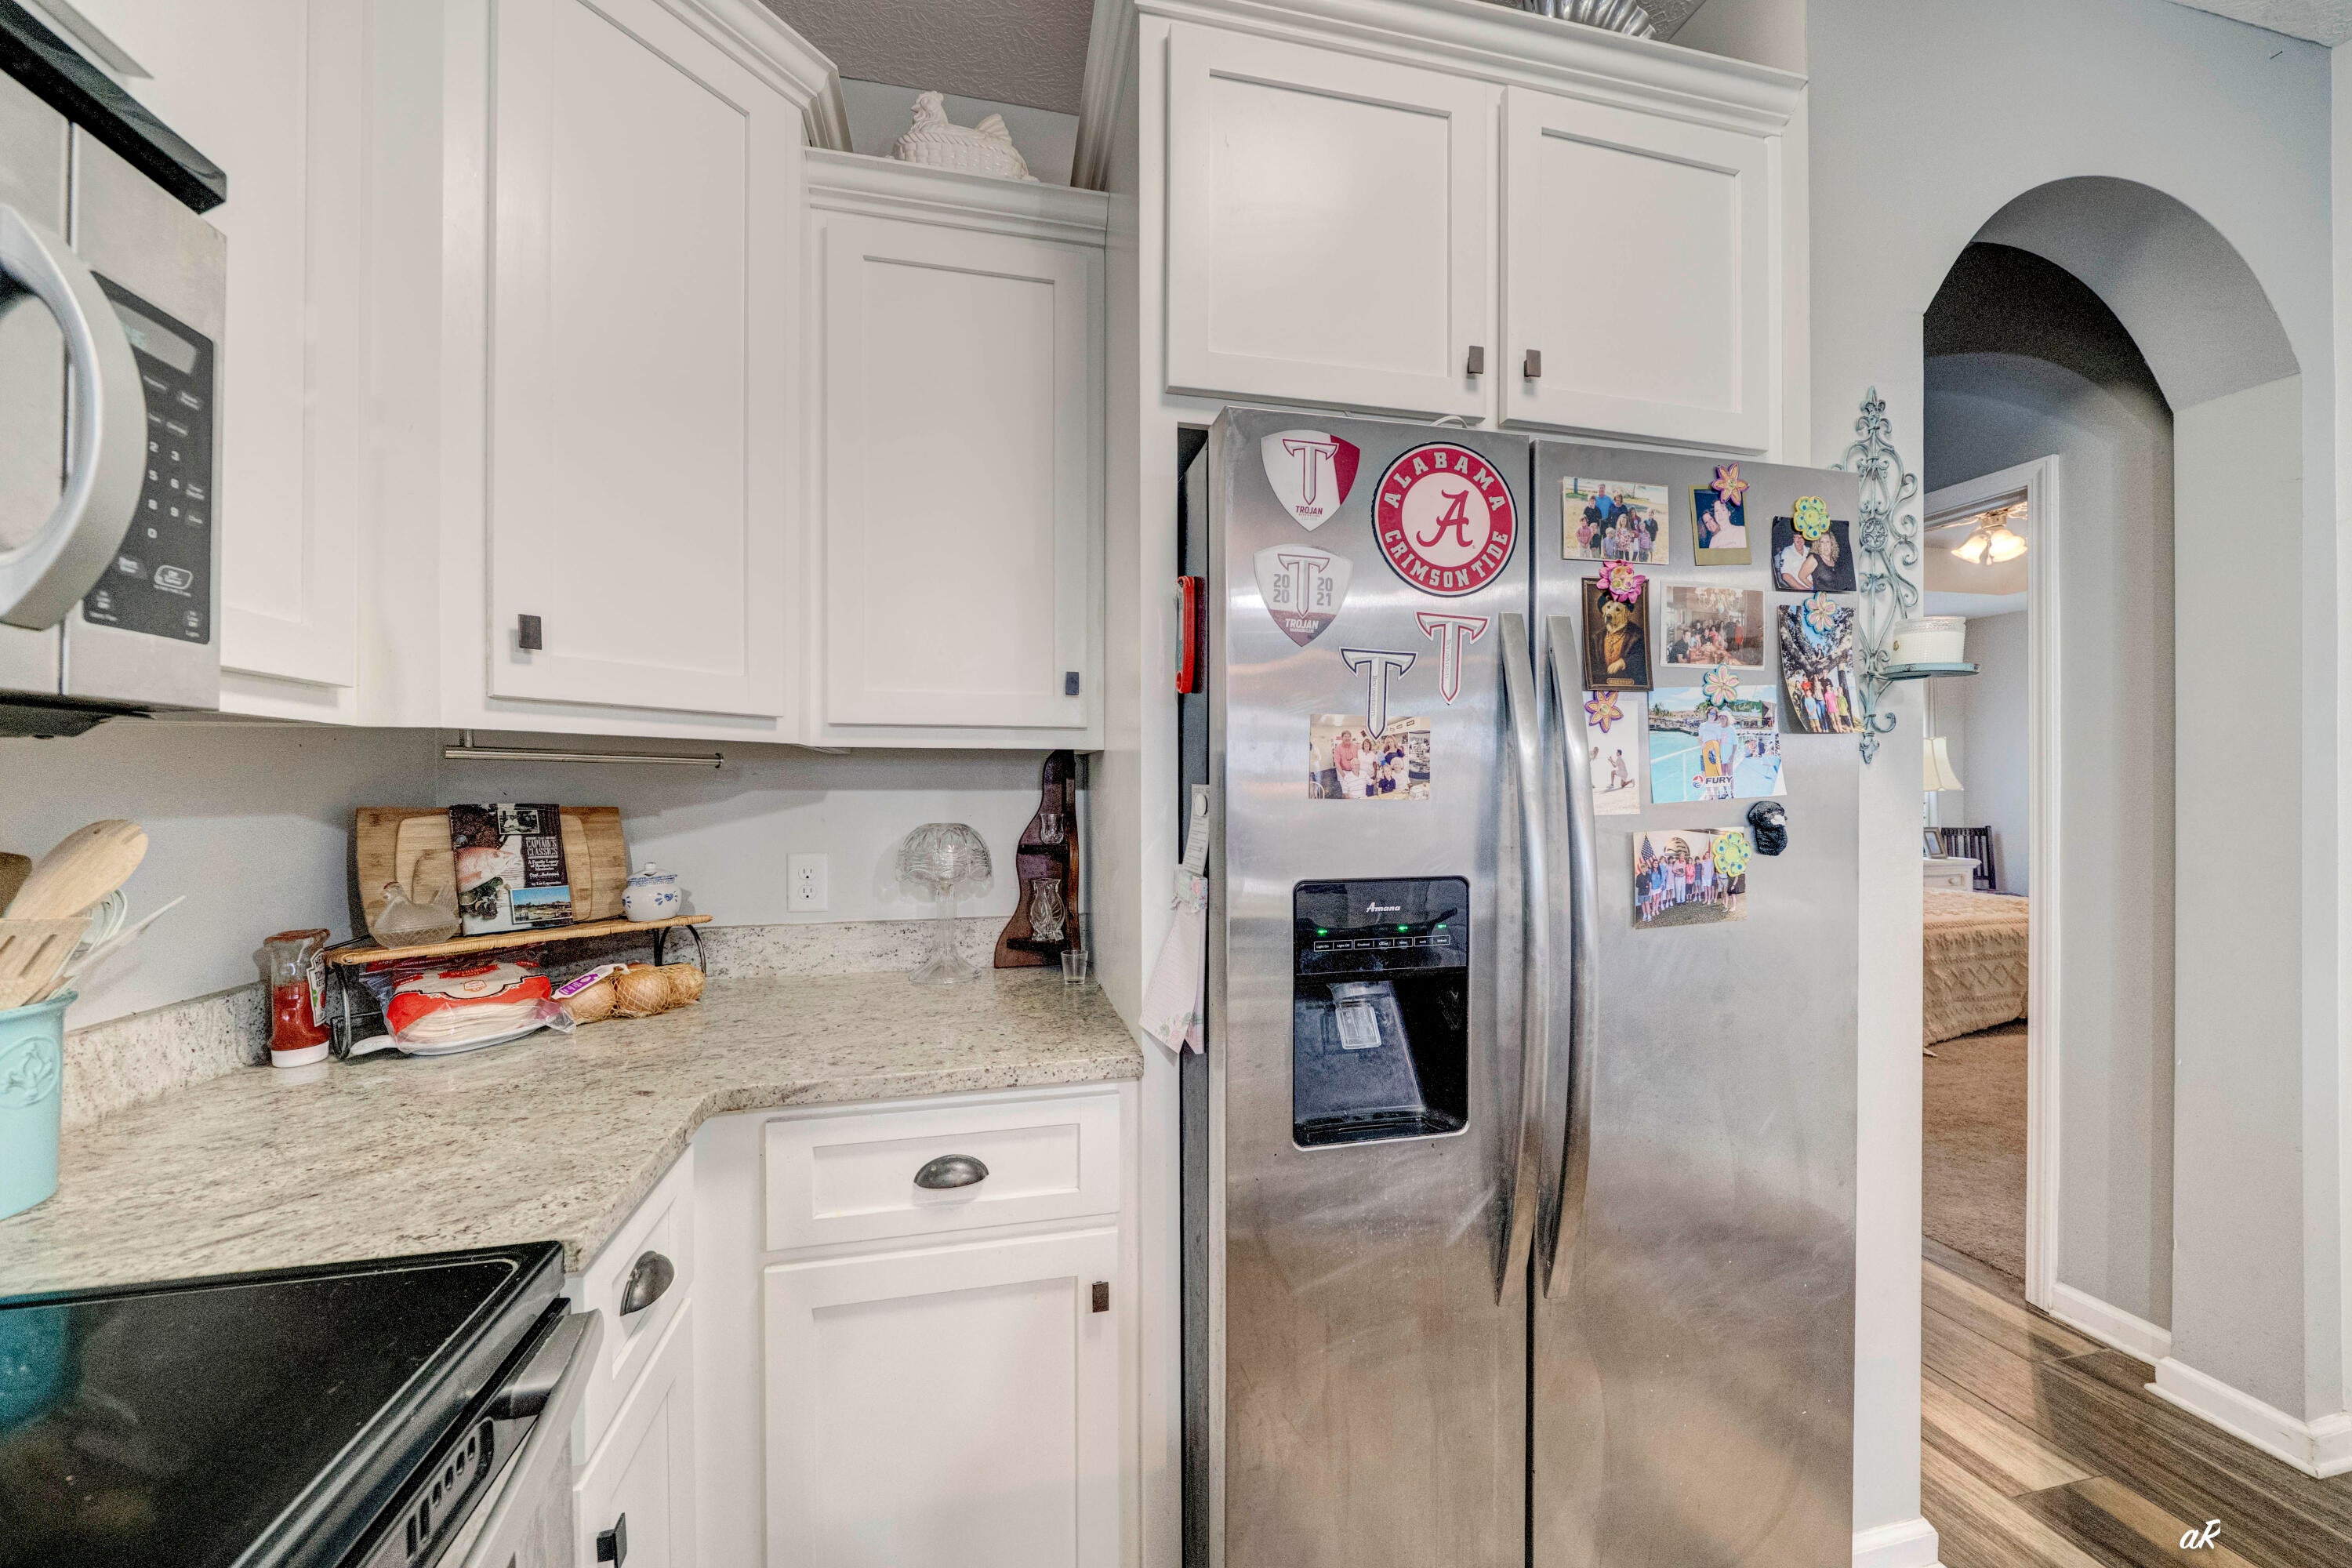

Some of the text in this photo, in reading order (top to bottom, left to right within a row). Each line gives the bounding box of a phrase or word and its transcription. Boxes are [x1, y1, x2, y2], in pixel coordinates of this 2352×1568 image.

[149, 441, 159, 453] 2
[171, 450, 180, 462] 3
[149, 469, 158, 481] 5
[1385, 452, 1506, 511] ALABAMA
[1295, 505, 1323, 515] TROJAN
[1416, 489, 1473, 547] A
[1385, 529, 1508, 587] CRIMSON TIDE
[1273, 573, 1290, 589] 20
[1317, 576, 1334, 592] 20
[1272, 588, 1290, 604] 20
[1316, 591, 1332, 607] 21
[1285, 618, 1319, 630] TROJAN
[1705, 776, 1733, 785] FURY
[1366, 902, 1401, 913] Amana
